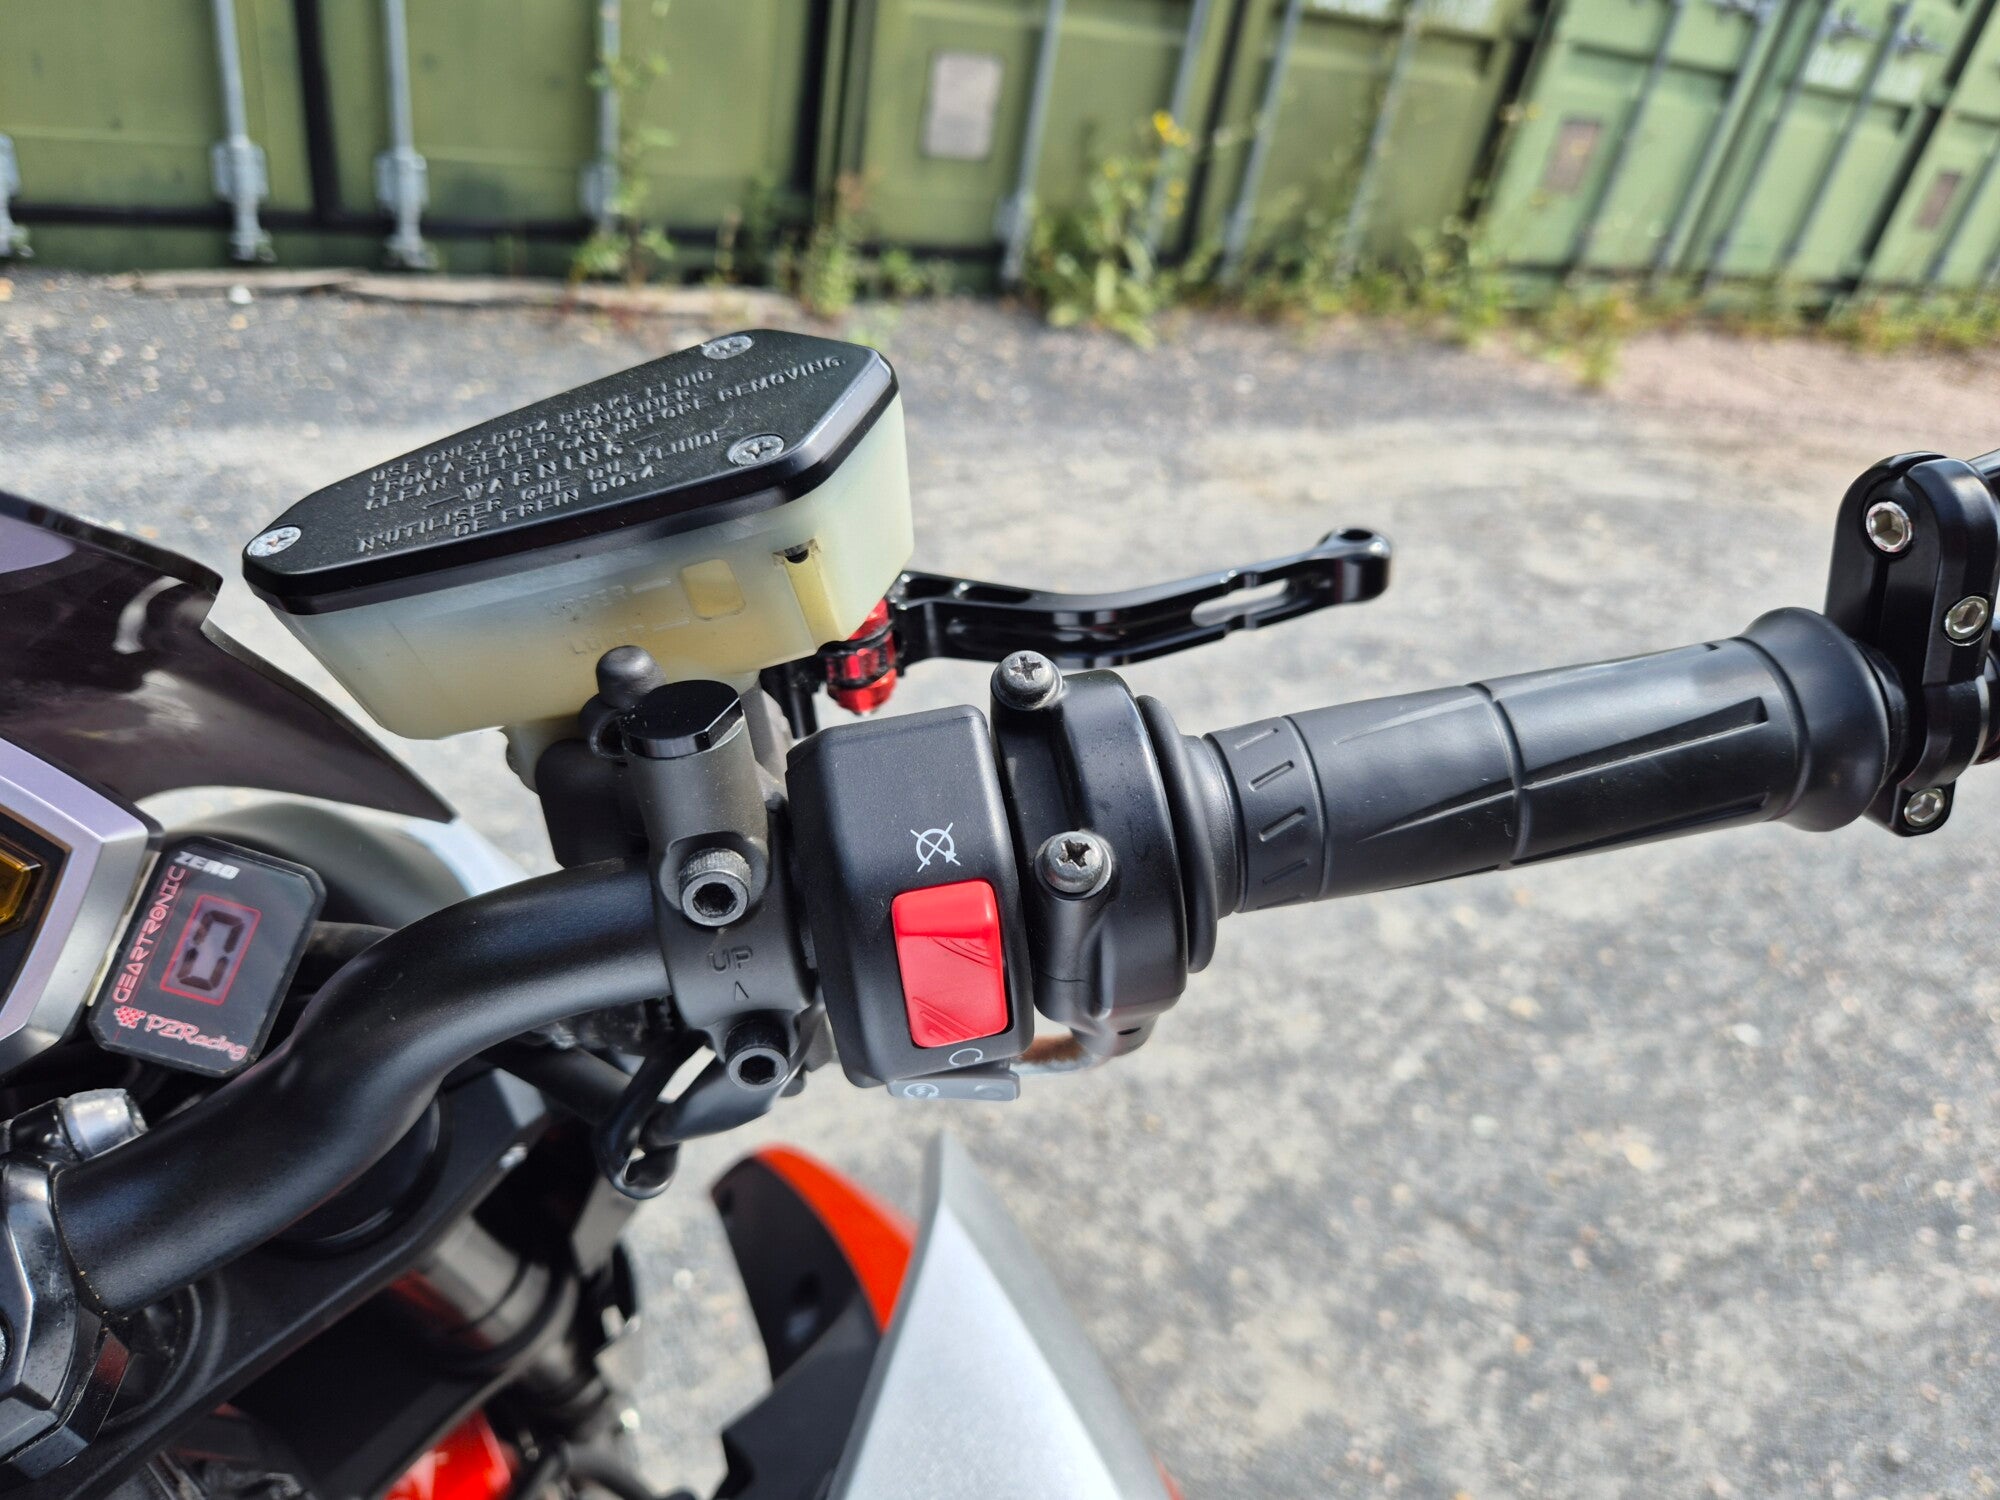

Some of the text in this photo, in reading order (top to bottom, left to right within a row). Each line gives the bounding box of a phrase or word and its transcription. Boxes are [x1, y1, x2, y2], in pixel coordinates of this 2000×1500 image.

[366, 476, 448, 511] CLEAN
[459, 446, 548, 483] FILLER
[614, 396, 711, 434] BEFORE
[371, 459, 417, 482] USE
[424, 439, 482, 467] ONLY
[559, 392, 638, 424] BRAKE
[645, 369, 713, 397] FLUID
[368, 467, 432, 498] FROM
[443, 461, 455, 474] A
[467, 431, 555, 466] SEALED
[465, 441, 623, 500] WARNING
[520, 476, 570, 501] QUE
[586, 460, 620, 481] DU
[639, 427, 732, 464] FLUIDE
[453, 520, 489, 537] DE
[501, 489, 580, 522] FREIN
[174, 851, 240, 880] ZERO
[112, 865, 187, 1004] GEARTRONIC
[707, 945, 753, 973] UP
[144, 1013, 248, 1060] PZRacing
